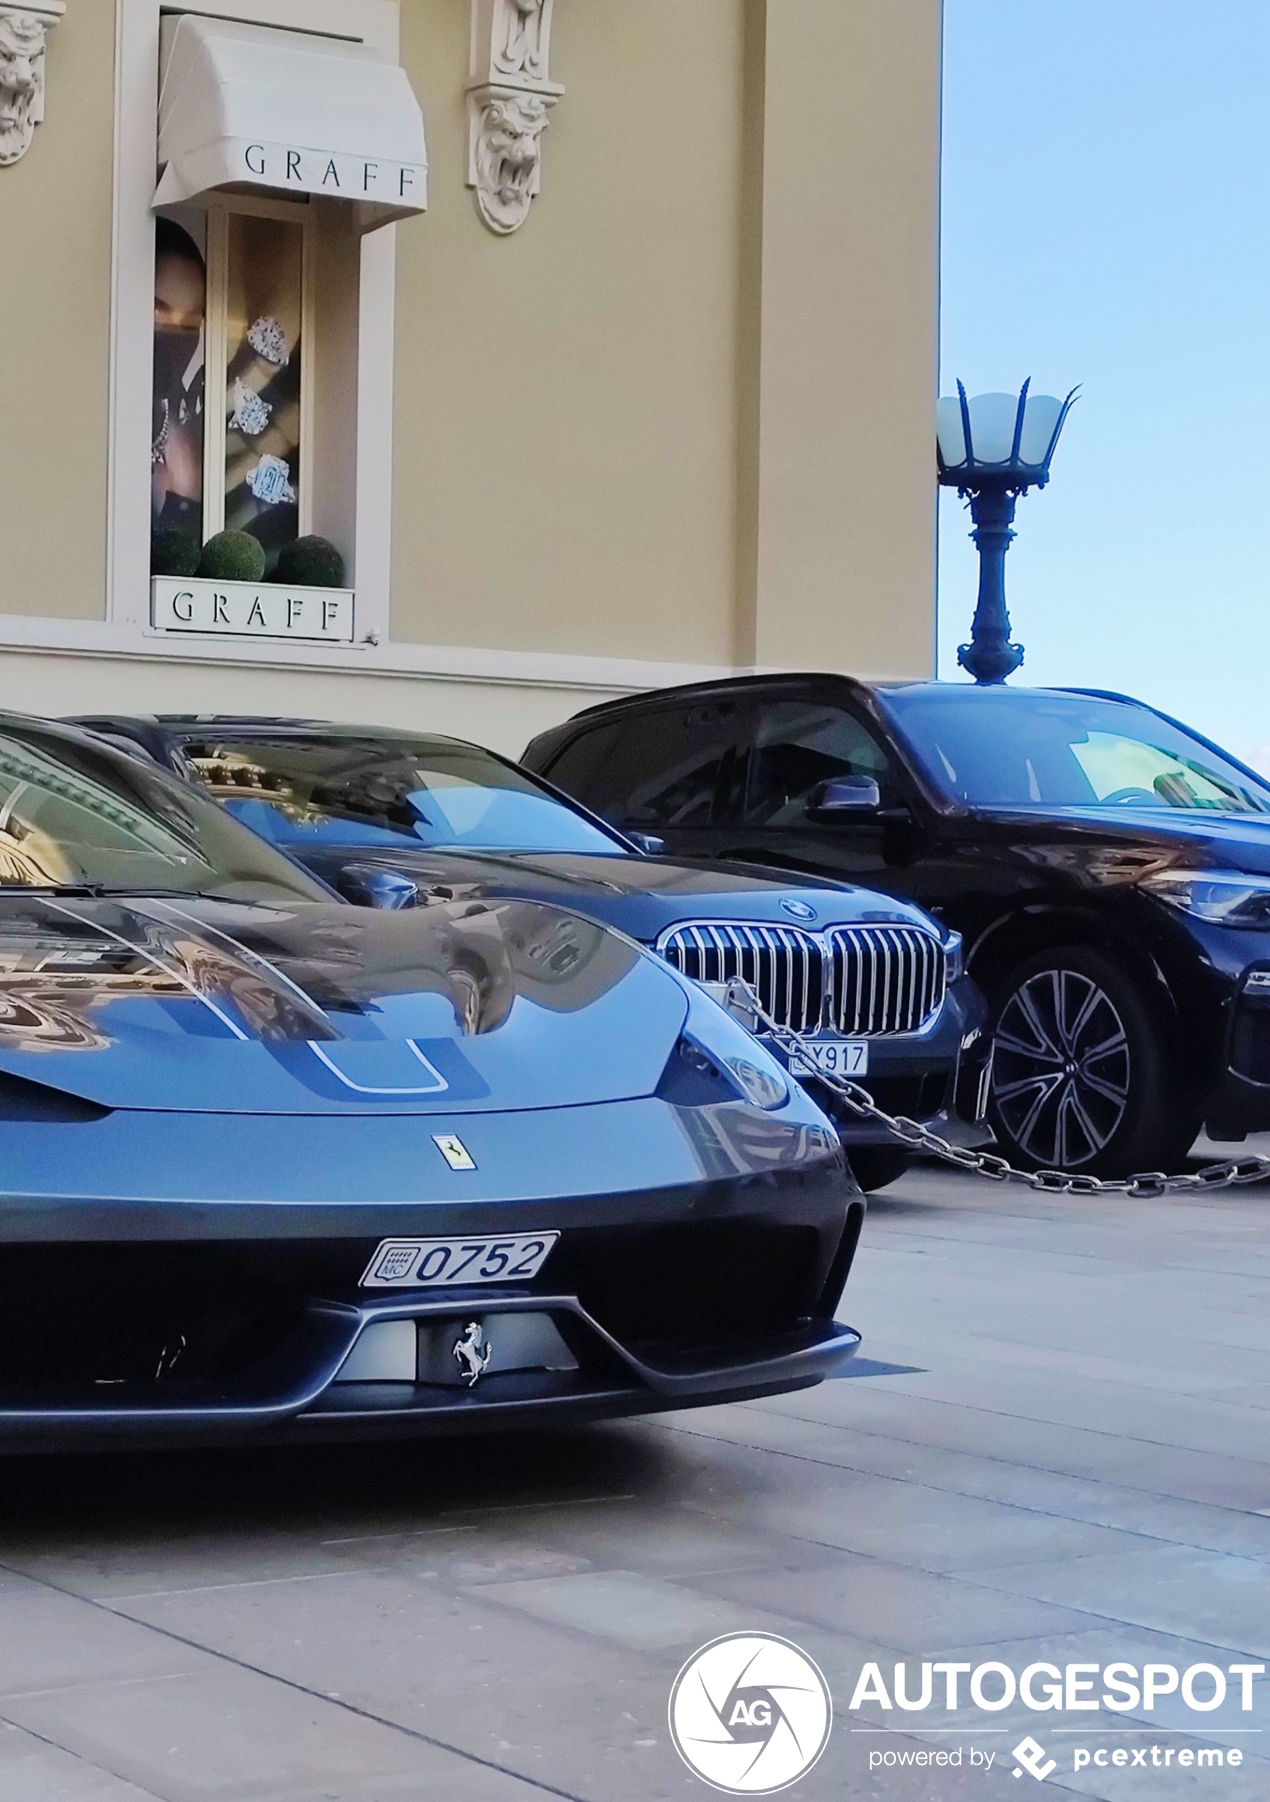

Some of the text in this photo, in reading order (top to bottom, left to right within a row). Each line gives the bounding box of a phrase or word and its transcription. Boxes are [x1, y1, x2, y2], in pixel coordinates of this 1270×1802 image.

[245, 145, 414, 196] GRAFF
[173, 591, 338, 630] GRAFF
[381, 1264, 403, 1275] MC
[416, 1241, 545, 1281] 0752
